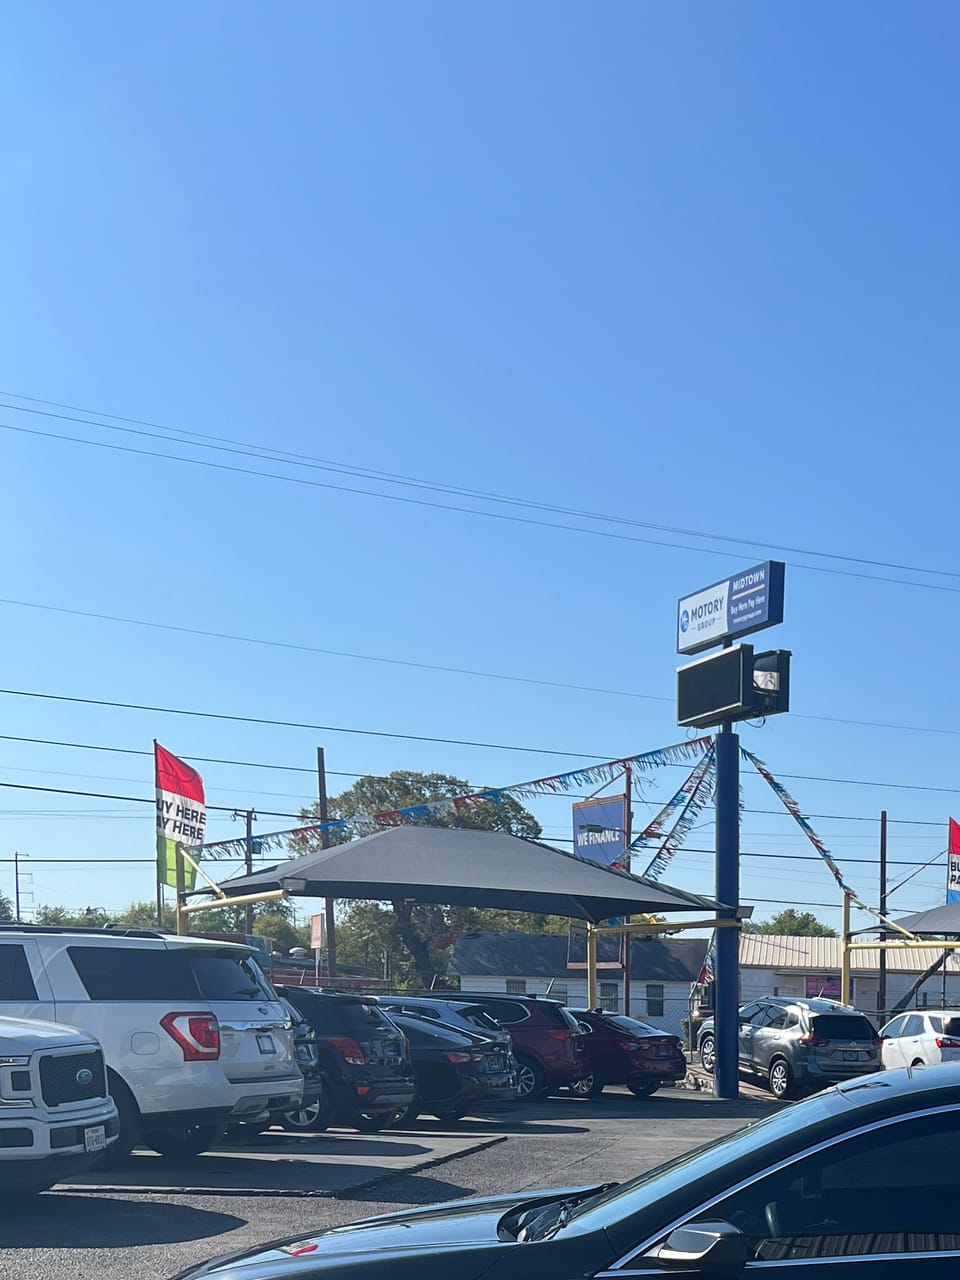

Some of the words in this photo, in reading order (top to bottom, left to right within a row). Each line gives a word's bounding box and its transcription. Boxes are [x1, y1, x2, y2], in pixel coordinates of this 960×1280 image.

[732, 569, 765, 592] MIDTOWN
[691, 596, 724, 621] MOTORY
[156, 798, 173, 814] UY
[176, 804, 206, 825] HERE
[156, 815, 170, 830] AY
[172, 820, 204, 840] HERE
[577, 832, 588, 846] WE
[589, 828, 620, 845] FINANCE
